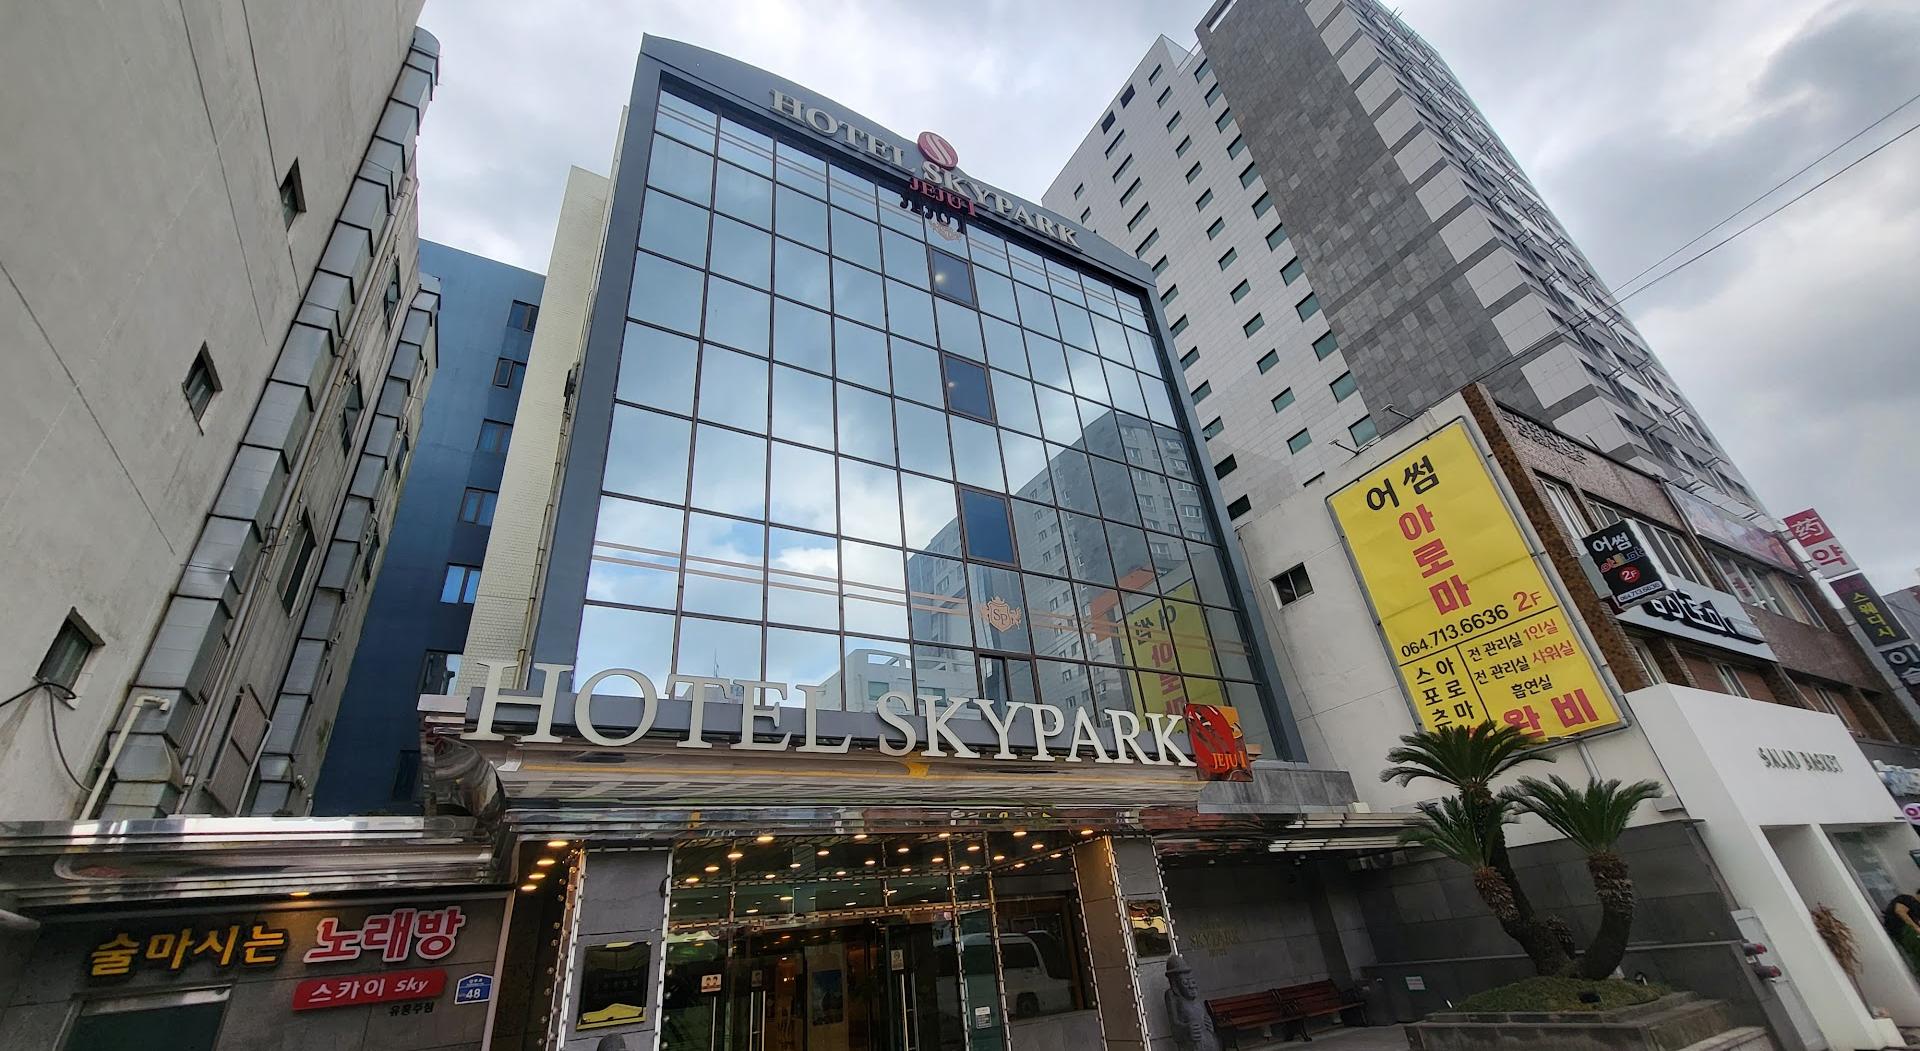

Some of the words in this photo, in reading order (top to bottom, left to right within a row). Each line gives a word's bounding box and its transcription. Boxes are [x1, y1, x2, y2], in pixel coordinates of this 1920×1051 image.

[769, 88, 915, 174] HOTEL
[922, 160, 1084, 250] SKYPARK
[909, 176, 962, 209] JEJU
[1366, 455, 1440, 511] 어썸
[1592, 531, 1633, 552] 어썸
[1811, 544, 1847, 567] 약
[1398, 503, 1472, 615] 아로마
[1622, 568, 1639, 580] 2F
[1401, 604, 1509, 657] 064.713.6636
[1512, 591, 1542, 612] 2F
[1467, 647, 1482, 662] 전
[1482, 632, 1524, 657] 관리실
[1522, 618, 1559, 641] 1인실
[1474, 669, 1489, 685] 전
[1489, 655, 1531, 680] 관리실
[1436, 656, 1475, 719] 아로마
[1511, 674, 1553, 699] 흡연실
[460, 660, 851, 755] HOTEL
[876, 690, 1198, 767] SKYPARK
[1212, 752, 1238, 770] JEJU
[1758, 746, 1801, 770] SALAD
[90, 924, 286, 976] 술마시는
[303, 905, 466, 964] 노래방
[308, 978, 386, 1002] 스카이
[466, 988, 481, 999] 48
